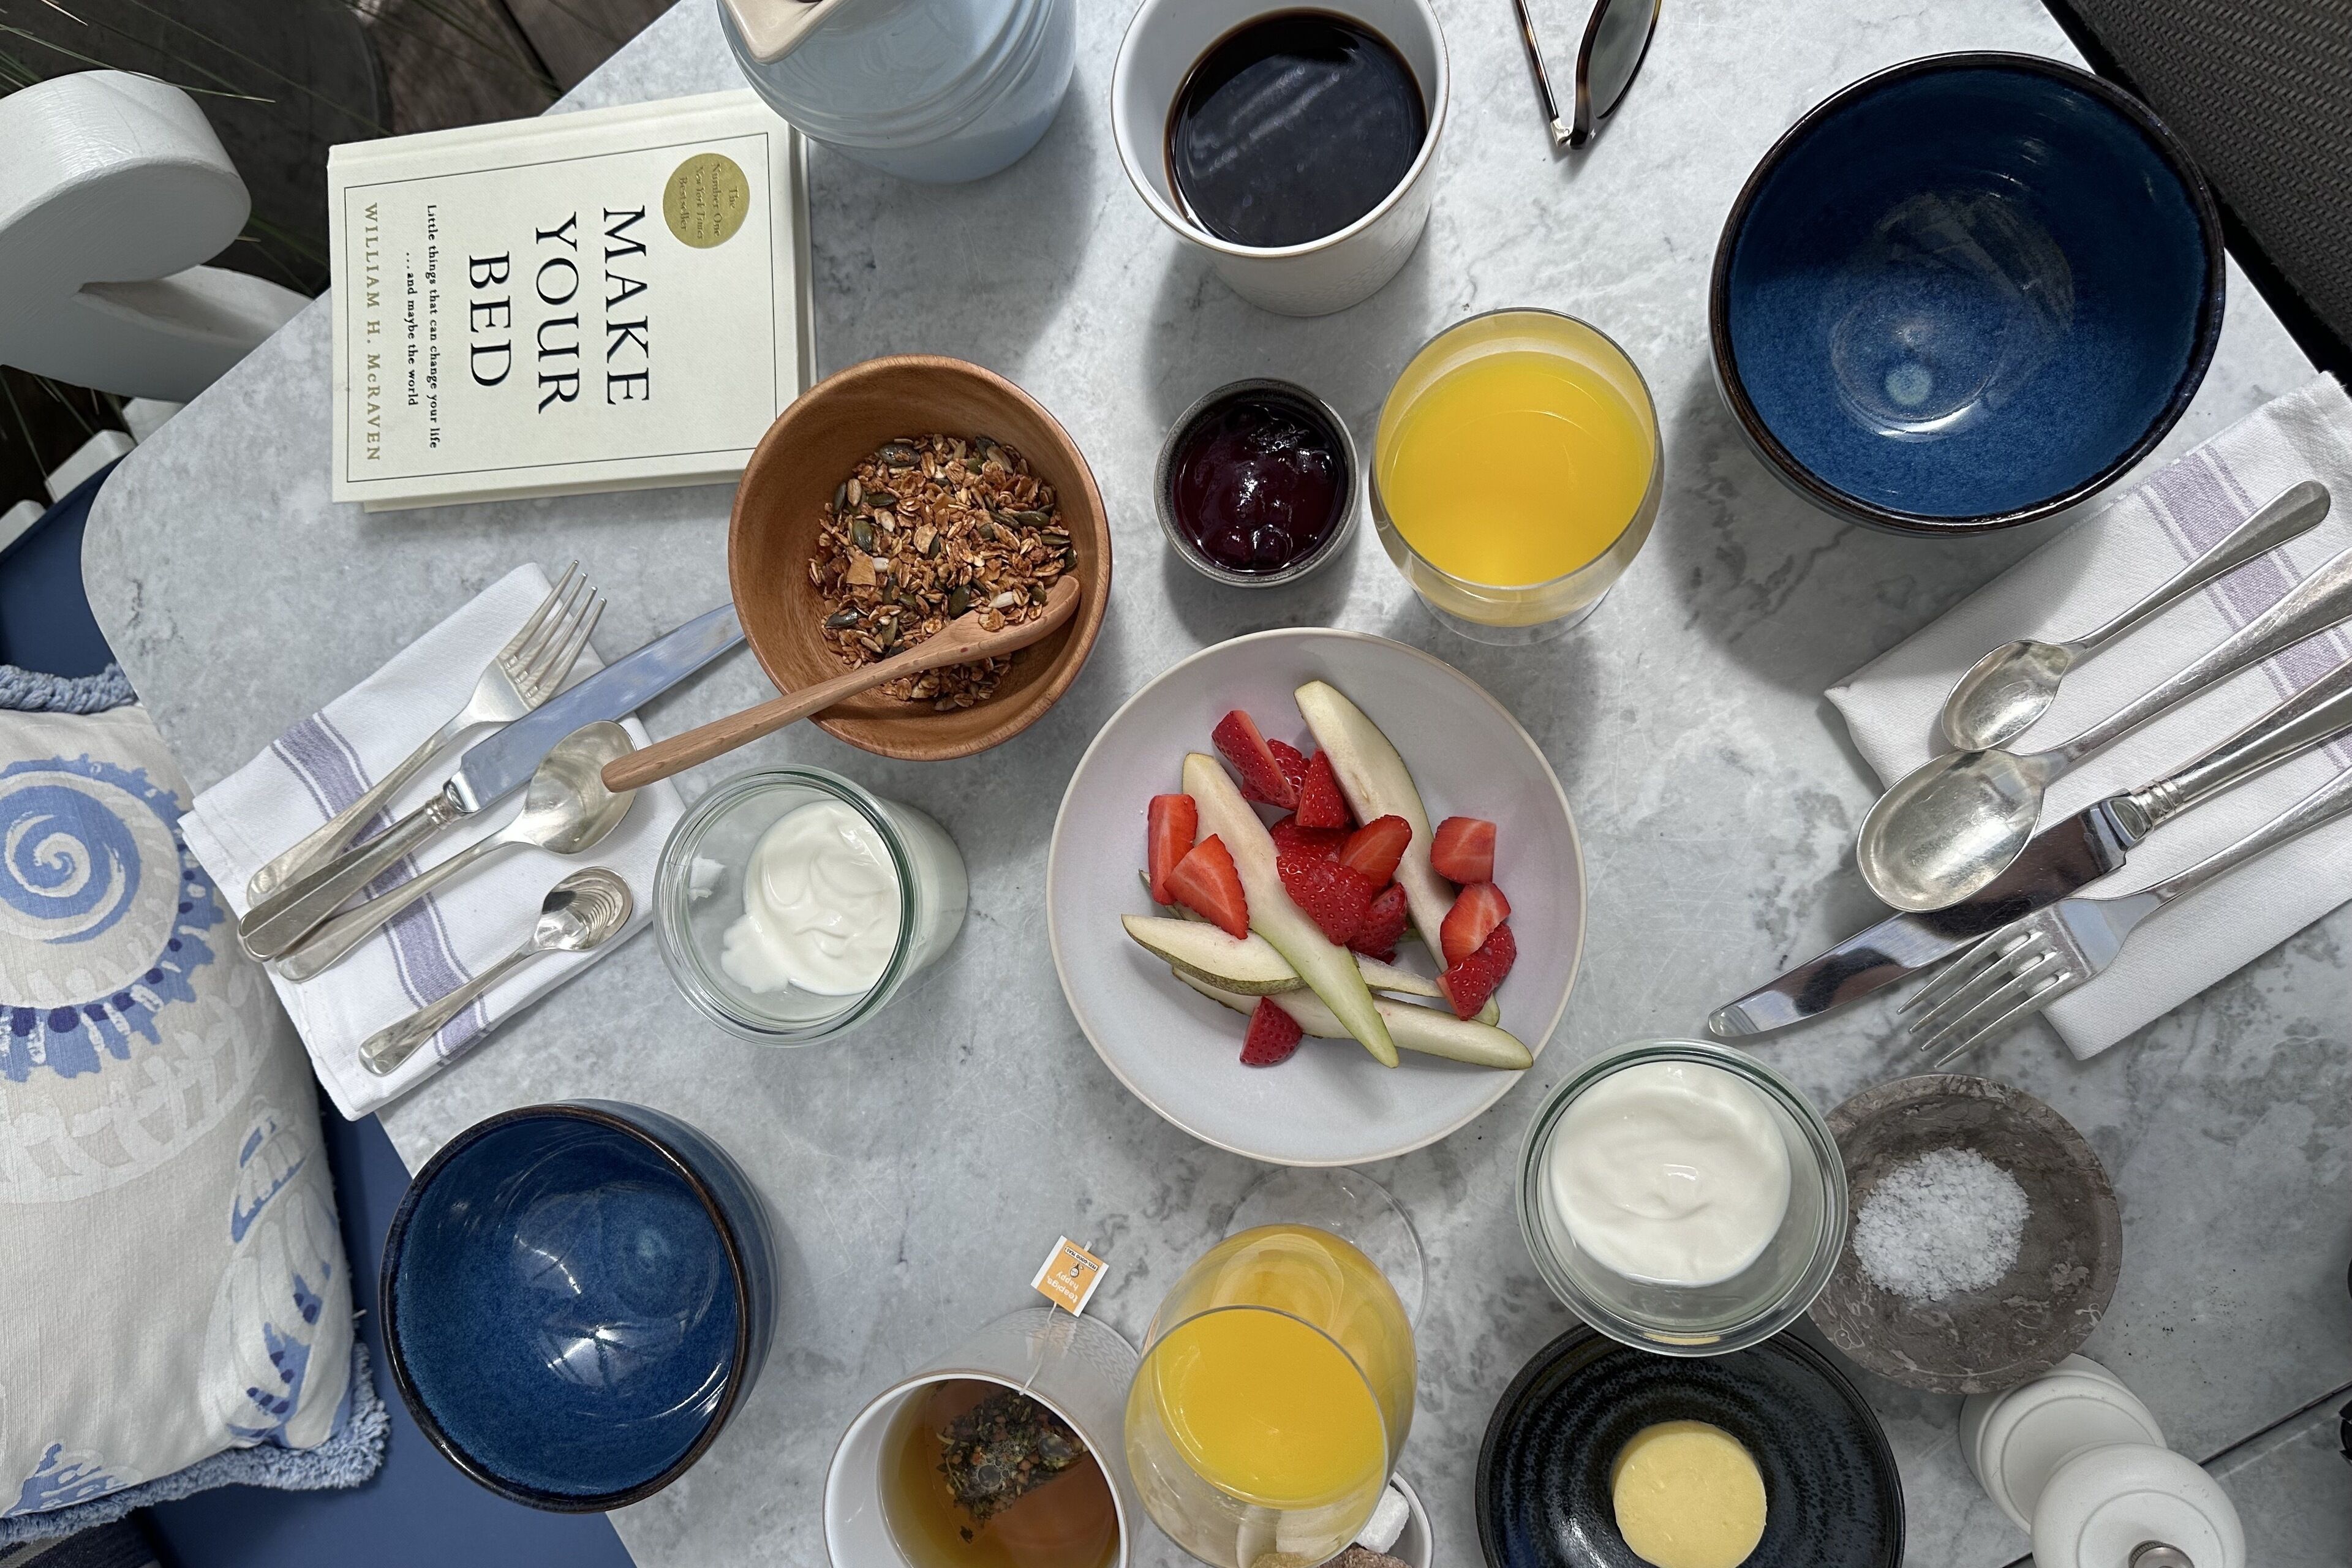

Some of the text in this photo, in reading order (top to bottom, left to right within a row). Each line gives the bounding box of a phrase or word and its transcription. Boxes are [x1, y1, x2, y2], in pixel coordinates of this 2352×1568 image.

[679, 176, 690, 231] Bestseller
[695, 166, 706, 239] New York Times
[712, 163, 723, 236] Number One
[729, 186, 739, 209] The
[427, 205, 439, 241] Little
[425, 245, 439, 285] things
[404, 300, 418, 339] maybe
[429, 289, 440, 315] that
[469, 251, 511, 386] BED
[535, 211, 580, 415] YOUR
[603, 205, 649, 405] MAKE
[364, 202, 381, 461] WILLIAM H. McRAVEN
[408, 344, 418, 364] the
[426, 345, 440, 390] change
[408, 369, 419, 406] world
[426, 394, 437, 423] your
[429, 428, 440, 448] life
[1056, 1270, 1080, 1292] happy
